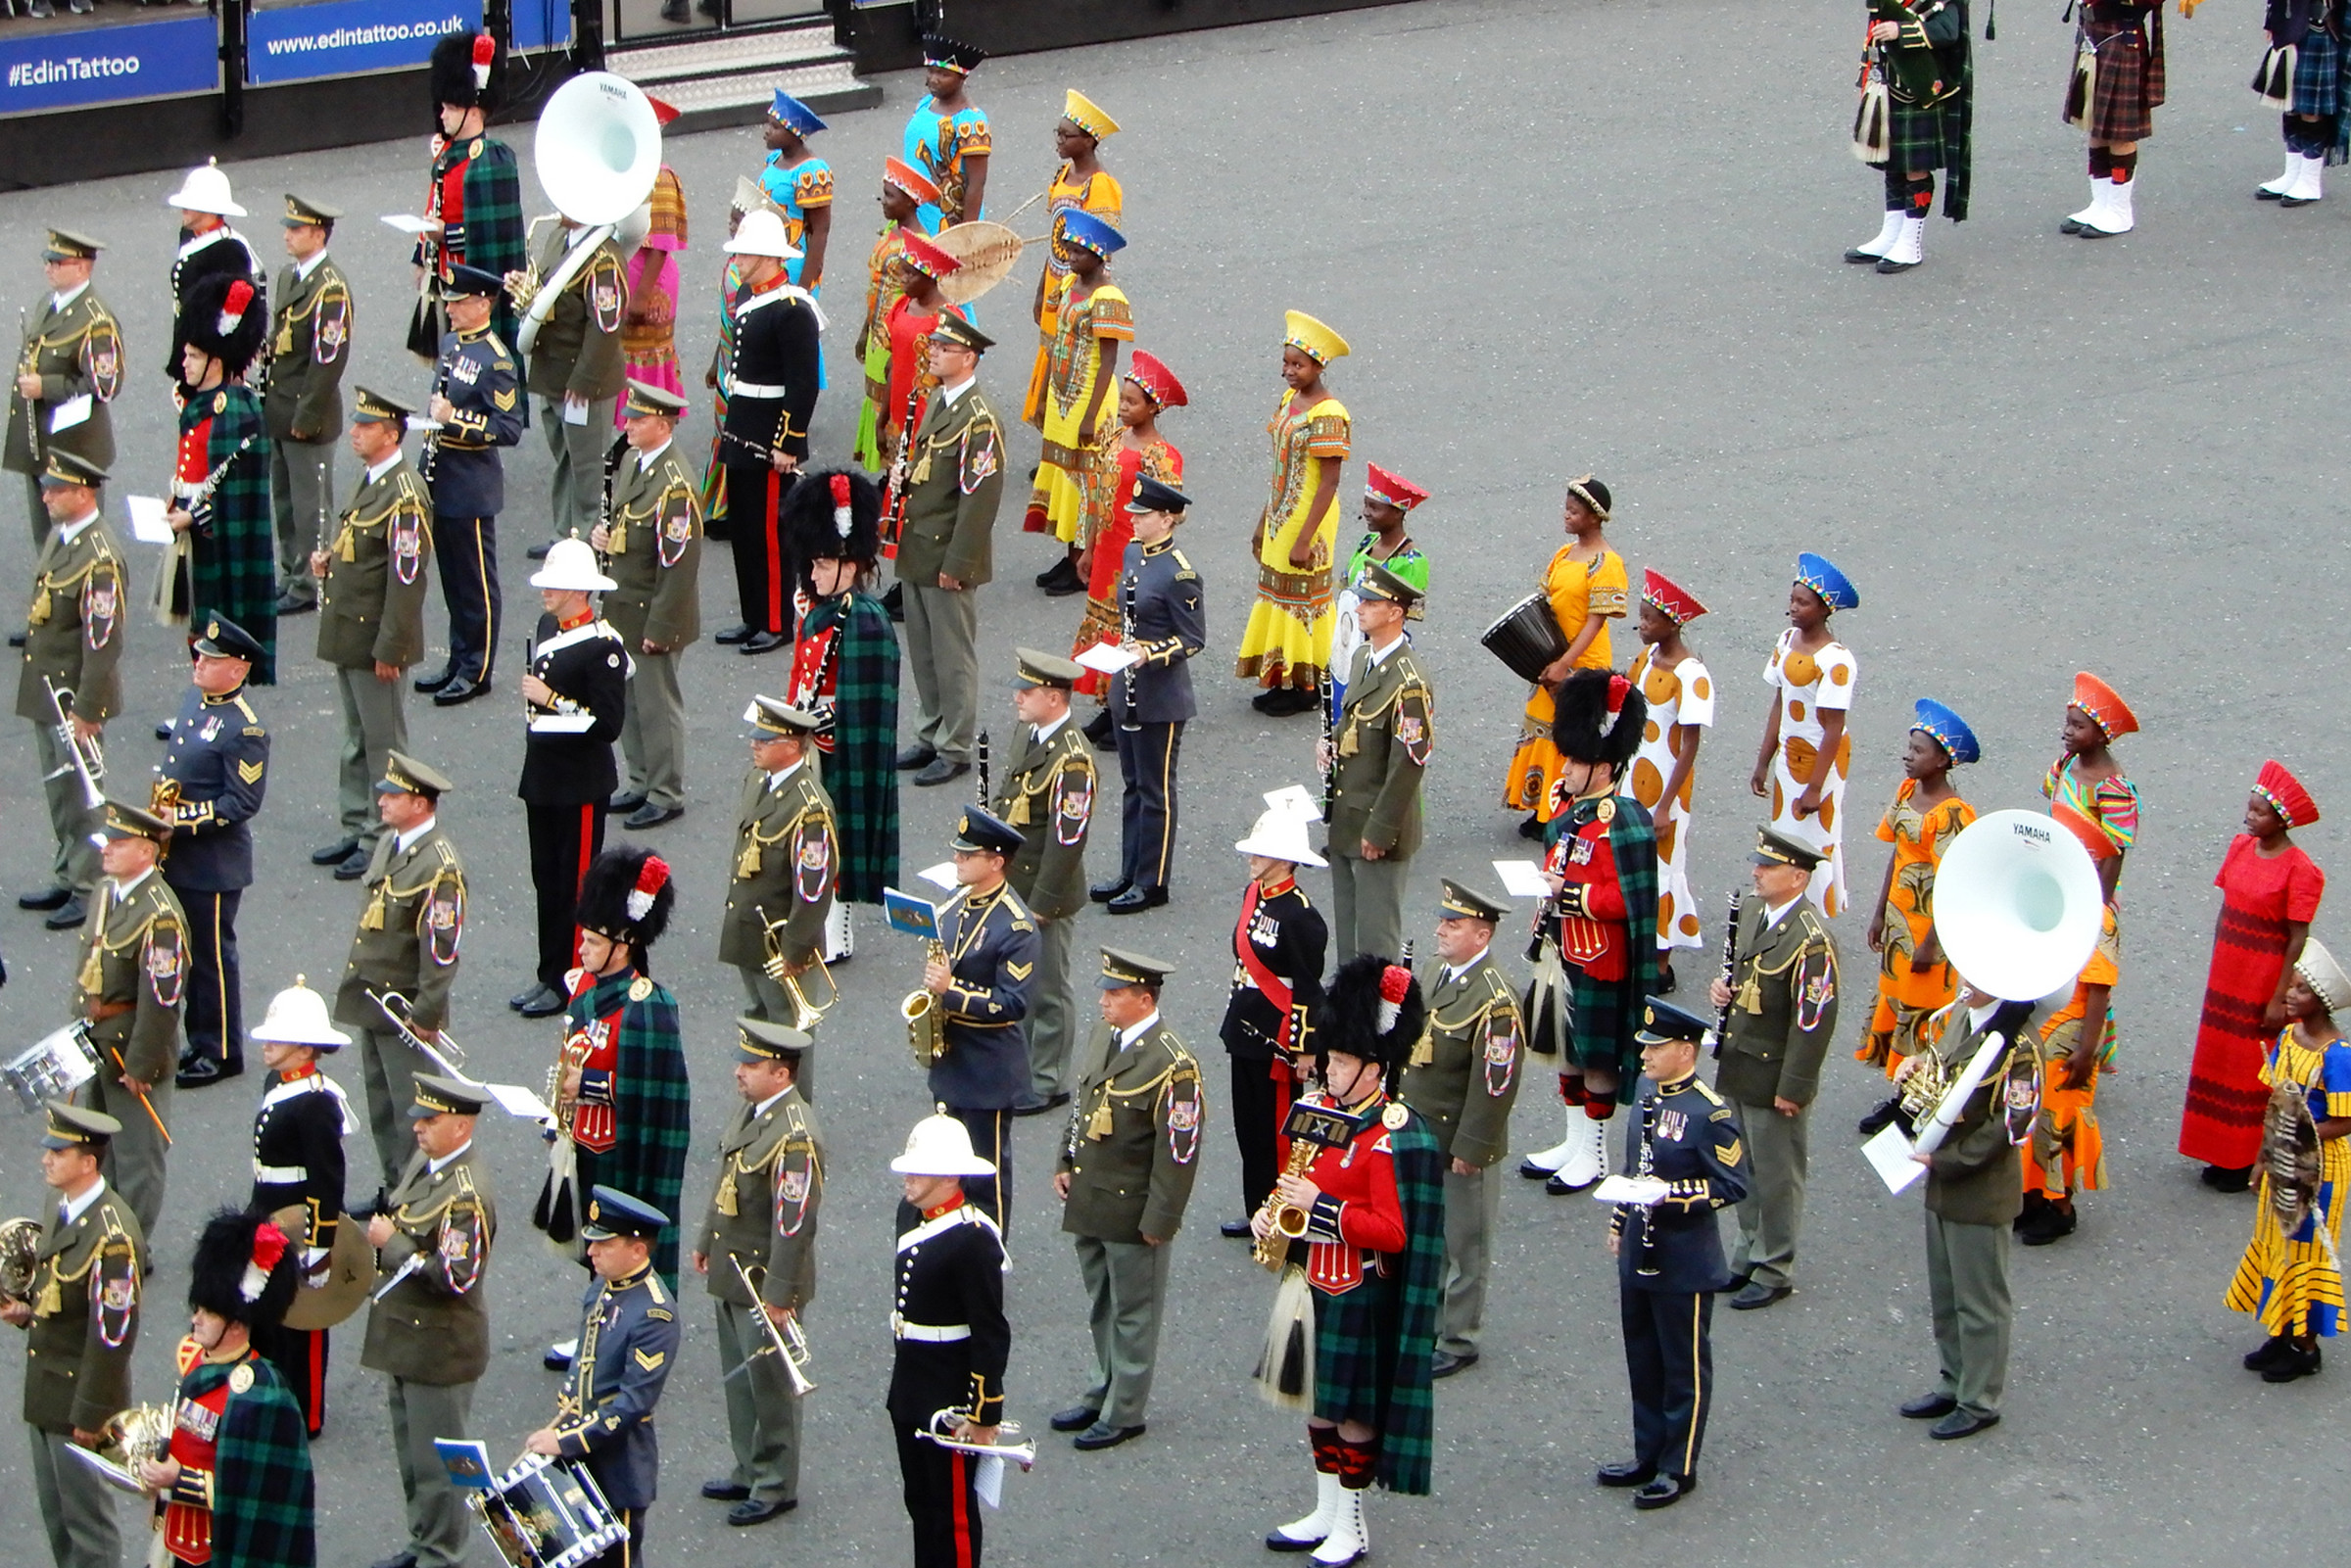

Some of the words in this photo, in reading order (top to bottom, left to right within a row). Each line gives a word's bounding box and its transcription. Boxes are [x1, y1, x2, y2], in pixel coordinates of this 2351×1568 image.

[267, 15, 463, 56] www.edintattoo.co.uk
[9, 55, 140, 88] #EdinTattoo
[2013, 823, 2051, 843] YAMAHA
